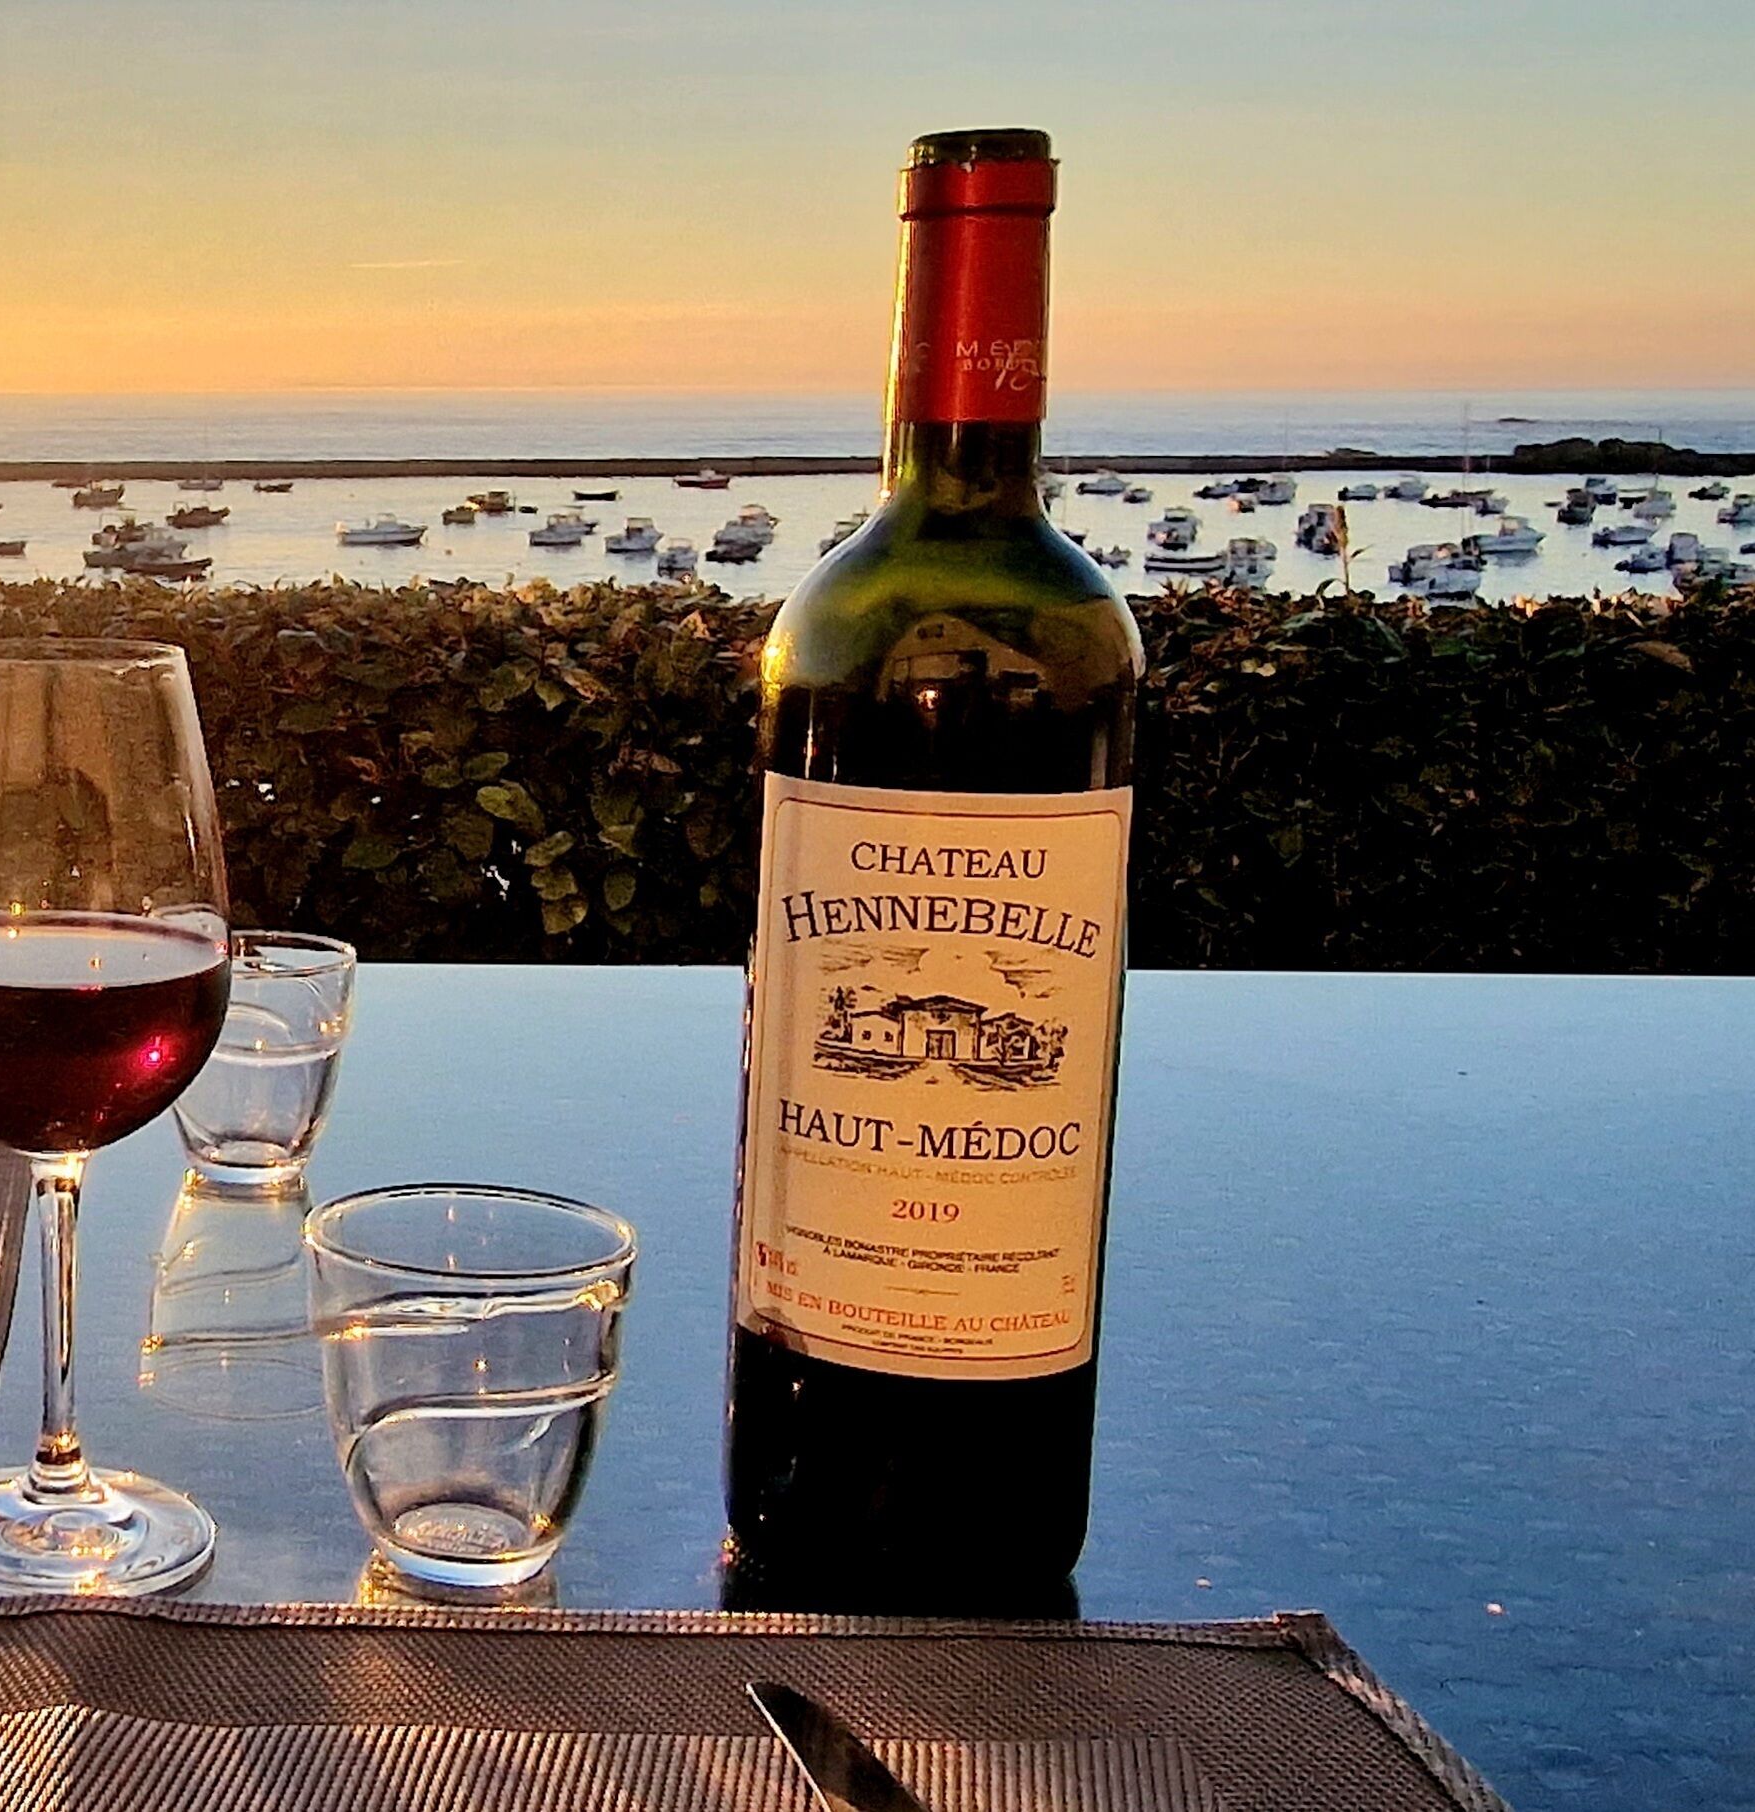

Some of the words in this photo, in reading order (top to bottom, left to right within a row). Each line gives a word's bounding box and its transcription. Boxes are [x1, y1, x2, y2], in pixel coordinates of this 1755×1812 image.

[851, 842, 1047, 878] CHATEAU
[782, 891, 1101, 959] HENNEBELLE
[779, 1099, 1080, 1160] HAUT-MÉDOC
[892, 1200, 960, 1223] 2019
[974, 1263, 1021, 1274] FRANCE
[766, 1281, 793, 1301] MIS
[797, 1291, 823, 1311] EN
[827, 1300, 947, 1330] BOUTEILLE
[953, 1317, 984, 1333] AU
